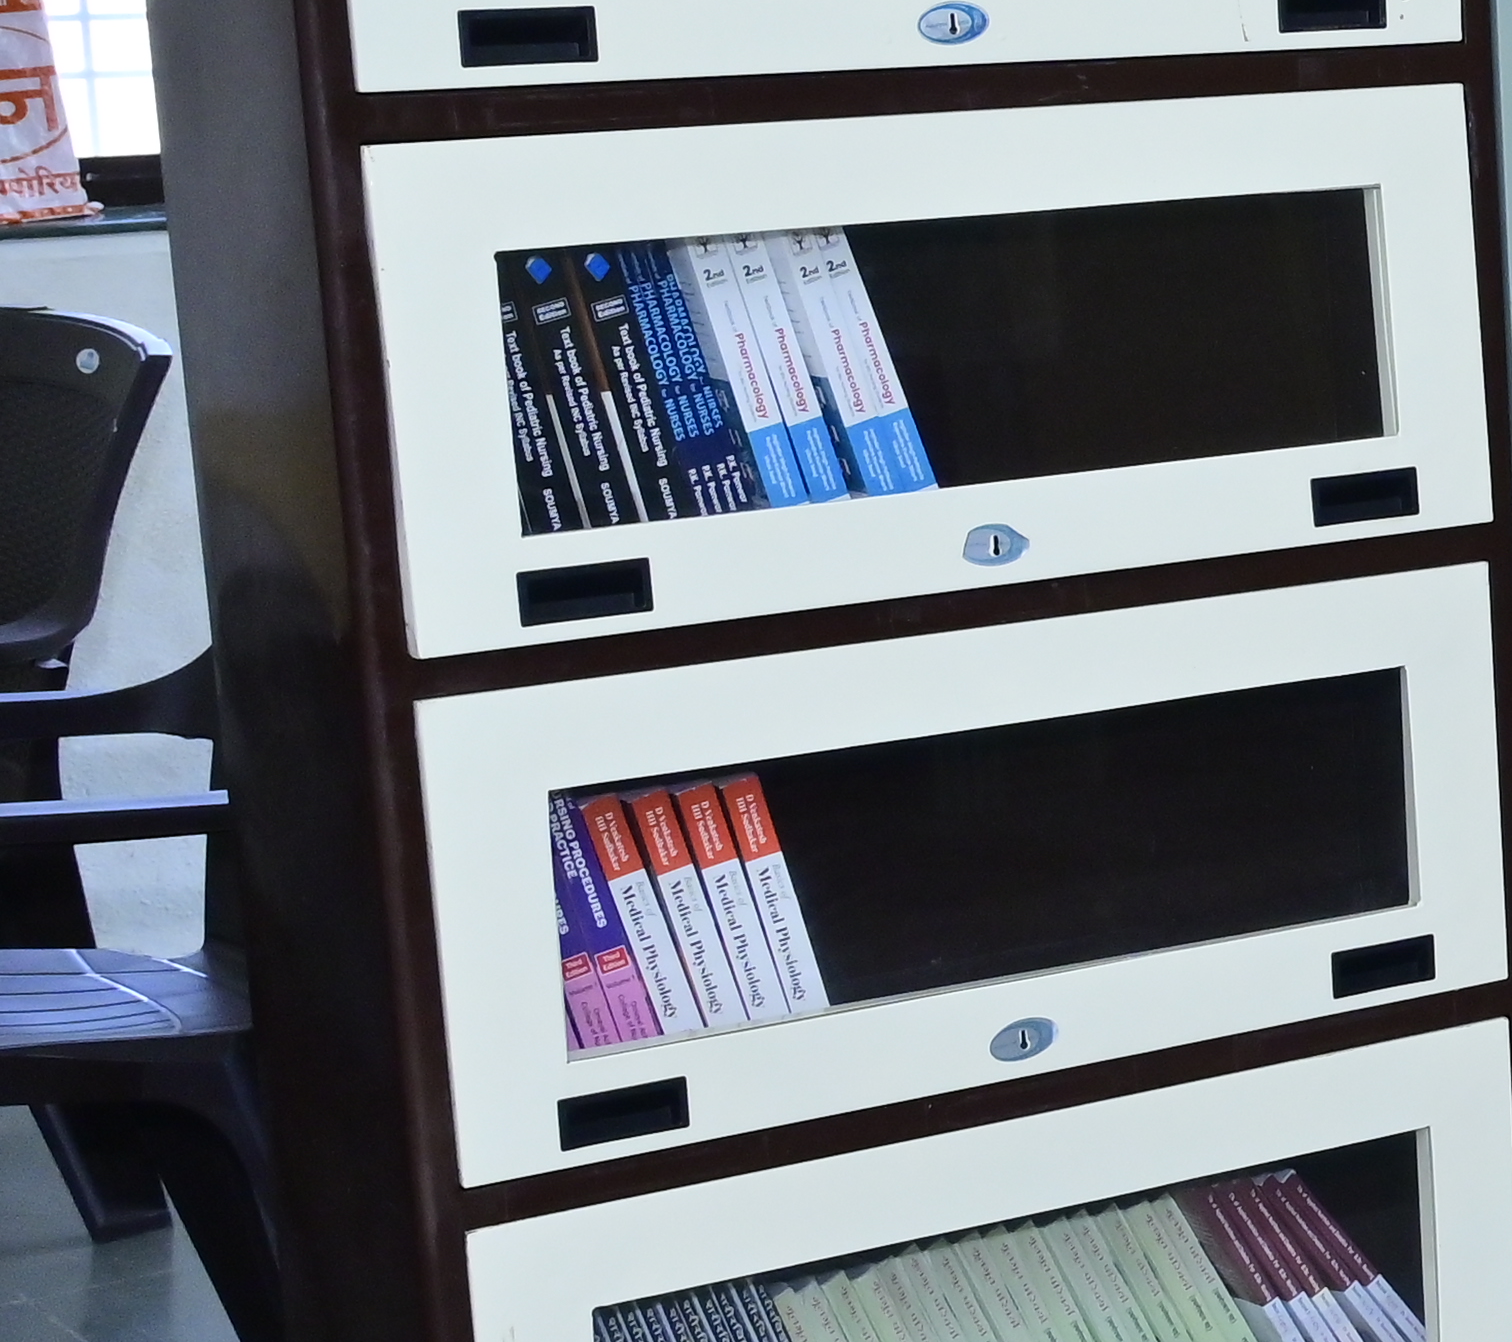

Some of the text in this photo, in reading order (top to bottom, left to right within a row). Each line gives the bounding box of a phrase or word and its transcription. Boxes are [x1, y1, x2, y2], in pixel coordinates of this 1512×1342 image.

[743, 265, 764, 277] 2nd
[826, 260, 847, 272] 2nd
[612, 355, 624, 370] per
[628, 285, 667, 385] PHARMACOLOGY
[640, 283, 681, 382] PHARMACOLOGY
[658, 280, 695, 381] PHARMACOLOGY
[774, 328, 810, 413] Pharmacology
[831, 329, 867, 413] Pharmacology
[859, 322, 896, 405] Pharmacology
[505, 331, 552, 477] Text book Pediatric Nursing
[553, 359, 590, 456] per Revised INC Syllabus
[559, 327, 609, 472] Text book of Pediatric Nursing
[618, 323, 668, 467] Text book of Pediatric Nursing
[619, 373, 636, 402] Revised
[629, 404, 640, 418] INC
[663, 398, 685, 441] NURSES
[677, 396, 698, 438] NURSES
[693, 394, 713, 435] NURSES
[632, 419, 649, 452] Syllabus
[601, 483, 620, 524] SOUMYA
[658, 478, 677, 519] SOUMYA
[567, 842, 607, 929] PROCEDURES
[668, 880, 724, 1015] Medical Physiology
[713, 874, 766, 1009] Medical Physiology
[756, 866, 807, 1002] Medical Physiology
